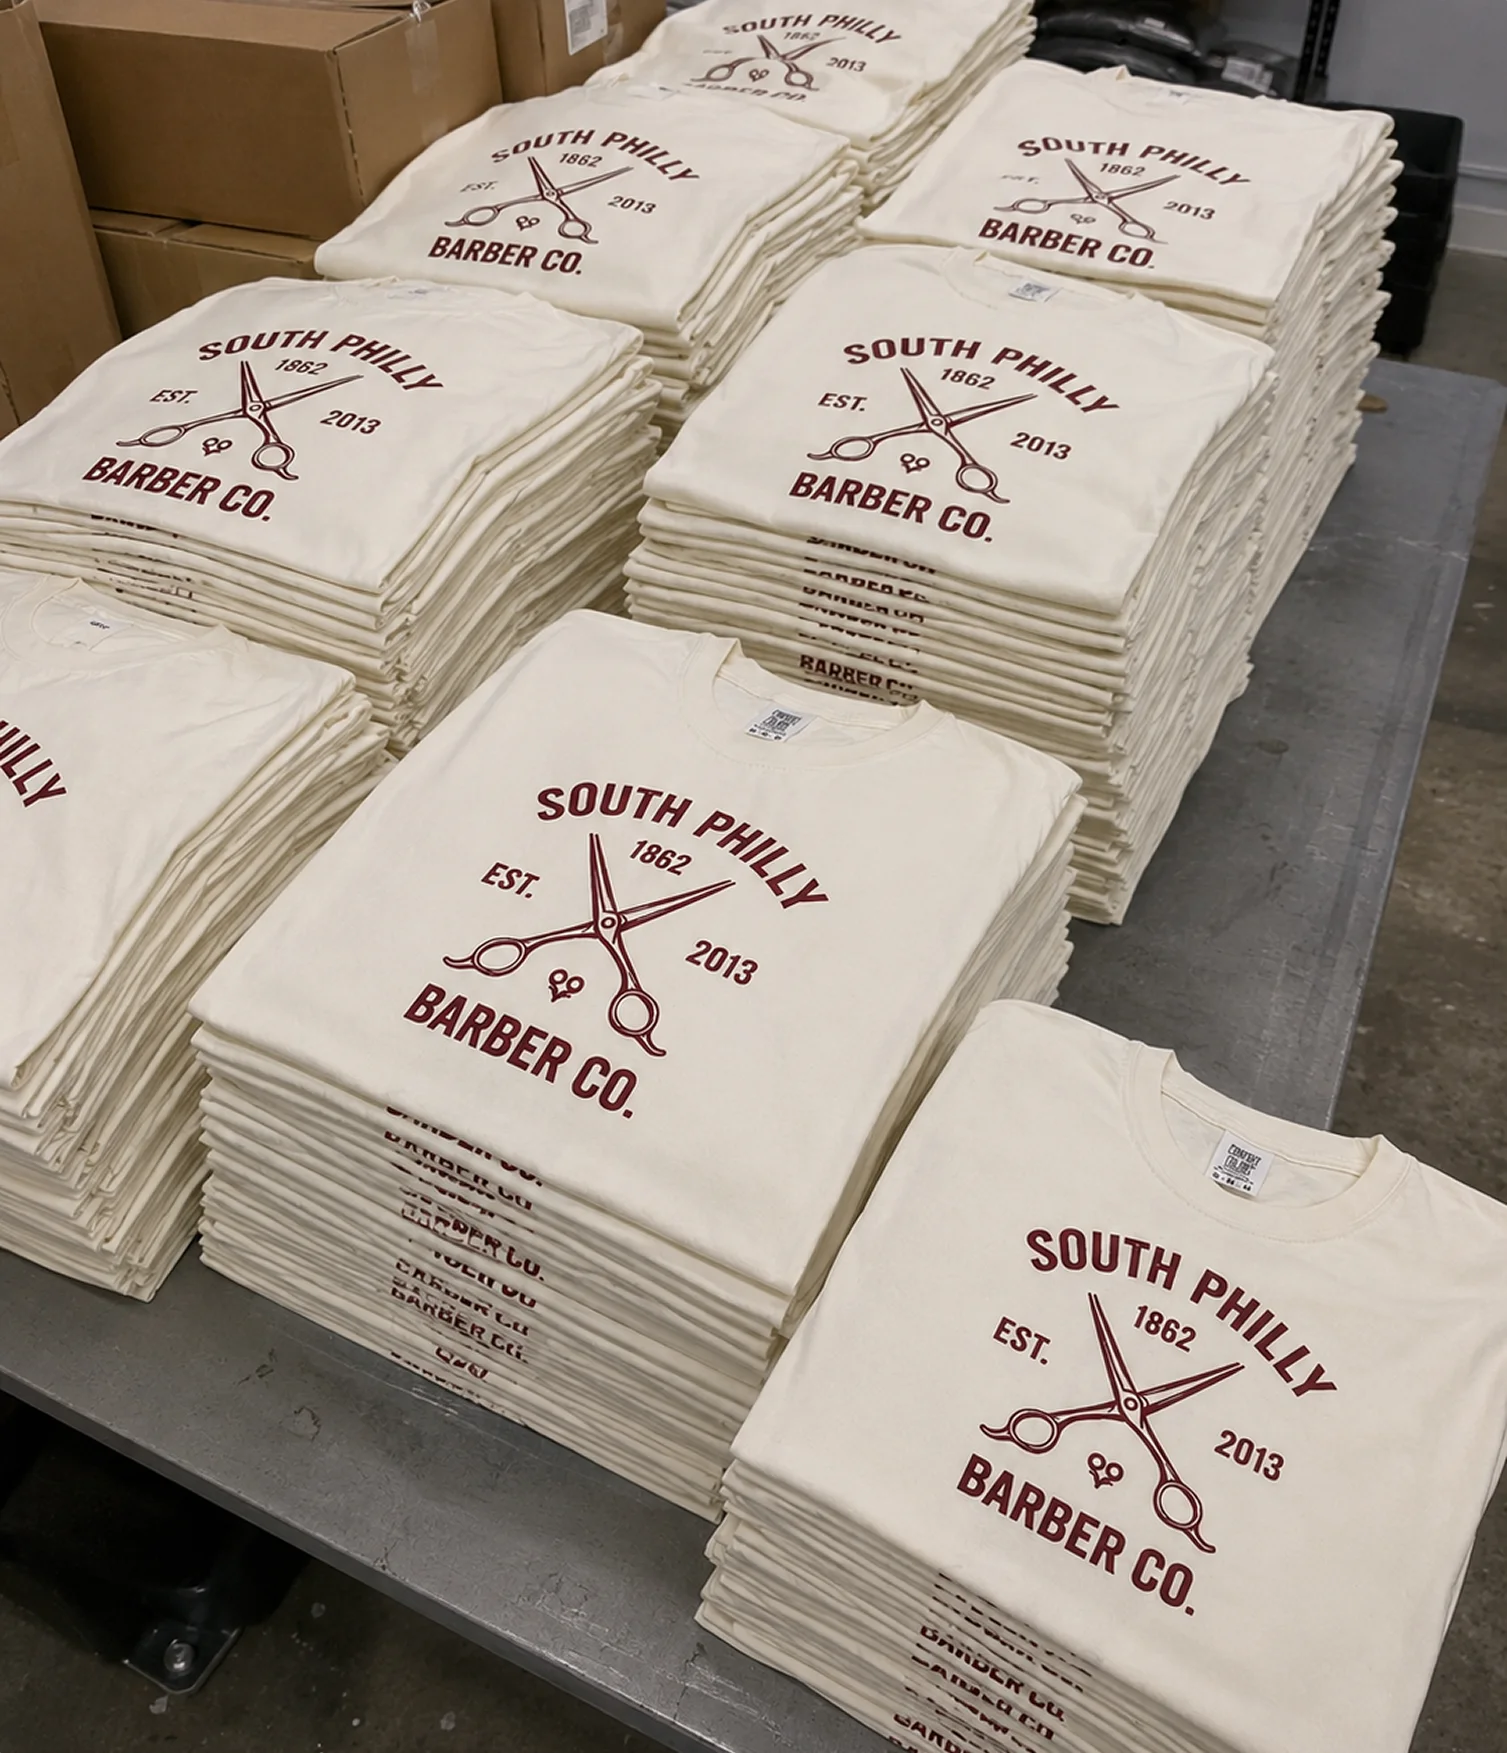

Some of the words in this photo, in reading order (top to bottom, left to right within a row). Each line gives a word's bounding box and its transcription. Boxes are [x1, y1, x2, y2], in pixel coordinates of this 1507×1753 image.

[723, 14, 813, 36] SOUTH
[817, 15, 901, 43] PHILLY
[784, 32, 820, 41] 1862
[826, 57, 866, 72] 2013
[492, 130, 595, 163] SOUTH
[601, 132, 699, 180] PHILLY
[560, 153, 602, 167] 1862
[1018, 137, 1129, 160] SOUTH
[1140, 145, 1250, 184] PHILLY
[1100, 163, 1145, 176] 1862
[460, 181, 498, 193] EST.
[608, 196, 656, 213] 2013
[1164, 202, 1215, 219] 2013
[428, 236, 538, 268] BARBER
[541, 250, 582, 275] CO.
[979, 218, 1102, 258] BARBER
[1107, 244, 1154, 268] CO.
[199, 330, 329, 360] SOUTH
[330, 334, 443, 390] PHILLY
[275, 359, 328, 375] 1862
[844, 338, 981, 364] SOUTH
[991, 347, 1119, 412] PHILLY
[941, 368, 995, 389] 1862
[150, 390, 198, 403] EST.
[818, 393, 867, 411] EST.
[320, 411, 381, 434] 2013
[1010, 432, 1071, 459] 2013
[83, 457, 221, 505] BARBER
[219, 485, 274, 521] CO.
[789, 472, 932, 524] BARBER
[938, 506, 992, 542] CO.
[0, 720, 66, 807] ILLY
[538, 782, 692, 828] SOUTH
[693, 811, 829, 909] PHILLY
[630, 841, 692, 875] 1862
[481, 862, 540, 898] EST.
[685, 941, 758, 985] 2013
[403, 983, 571, 1083] BARBER
[573, 1056, 637, 1119] CO.
[1027, 1228, 1181, 1290] SOUTH
[1190, 1269, 1337, 1397] PHILLY
[1134, 1306, 1196, 1352] 1862
[993, 1317, 1050, 1365] EST.
[1214, 1430, 1284, 1481] 2013
[957, 1453, 1126, 1575] BARBER
[1131, 1548, 1194, 1616] CO.
